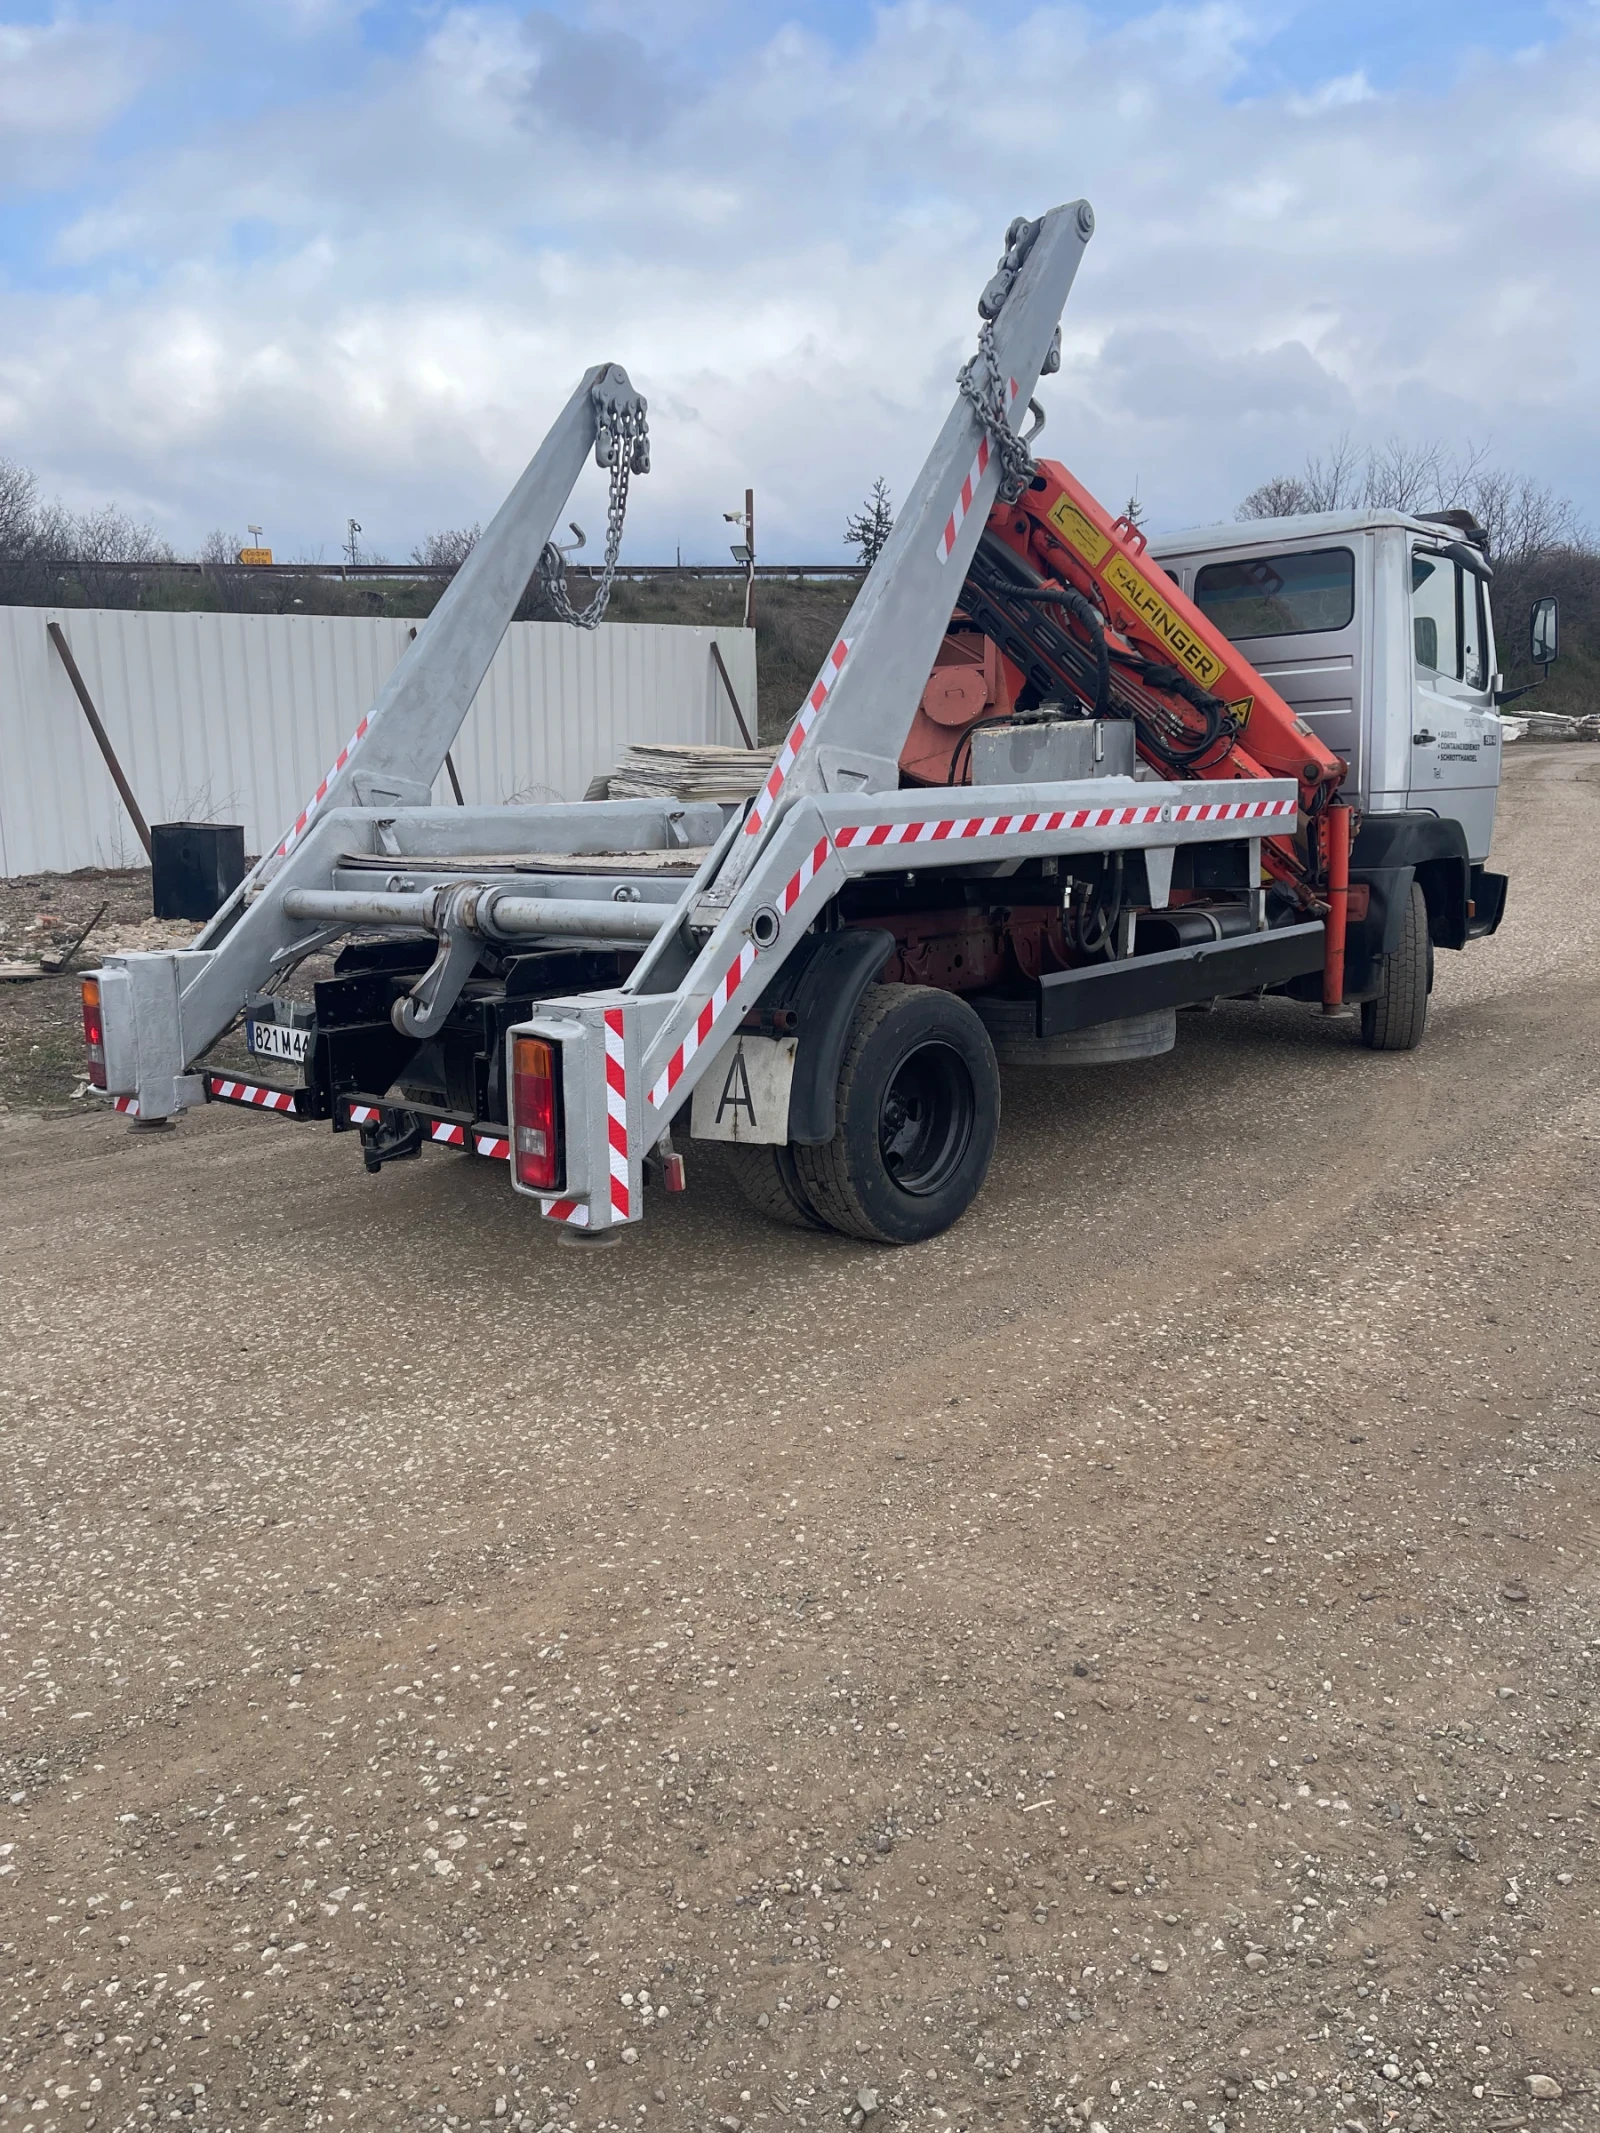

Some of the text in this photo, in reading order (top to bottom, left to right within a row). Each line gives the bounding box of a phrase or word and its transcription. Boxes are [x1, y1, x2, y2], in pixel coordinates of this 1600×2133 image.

[1112, 566, 1213, 678] PALFINGER
[1440, 754, 1477, 762] SCHROTTHANDEL
[1441, 742, 1480, 750] CONTAINERDIENST
[715, 1053, 757, 1127] A
